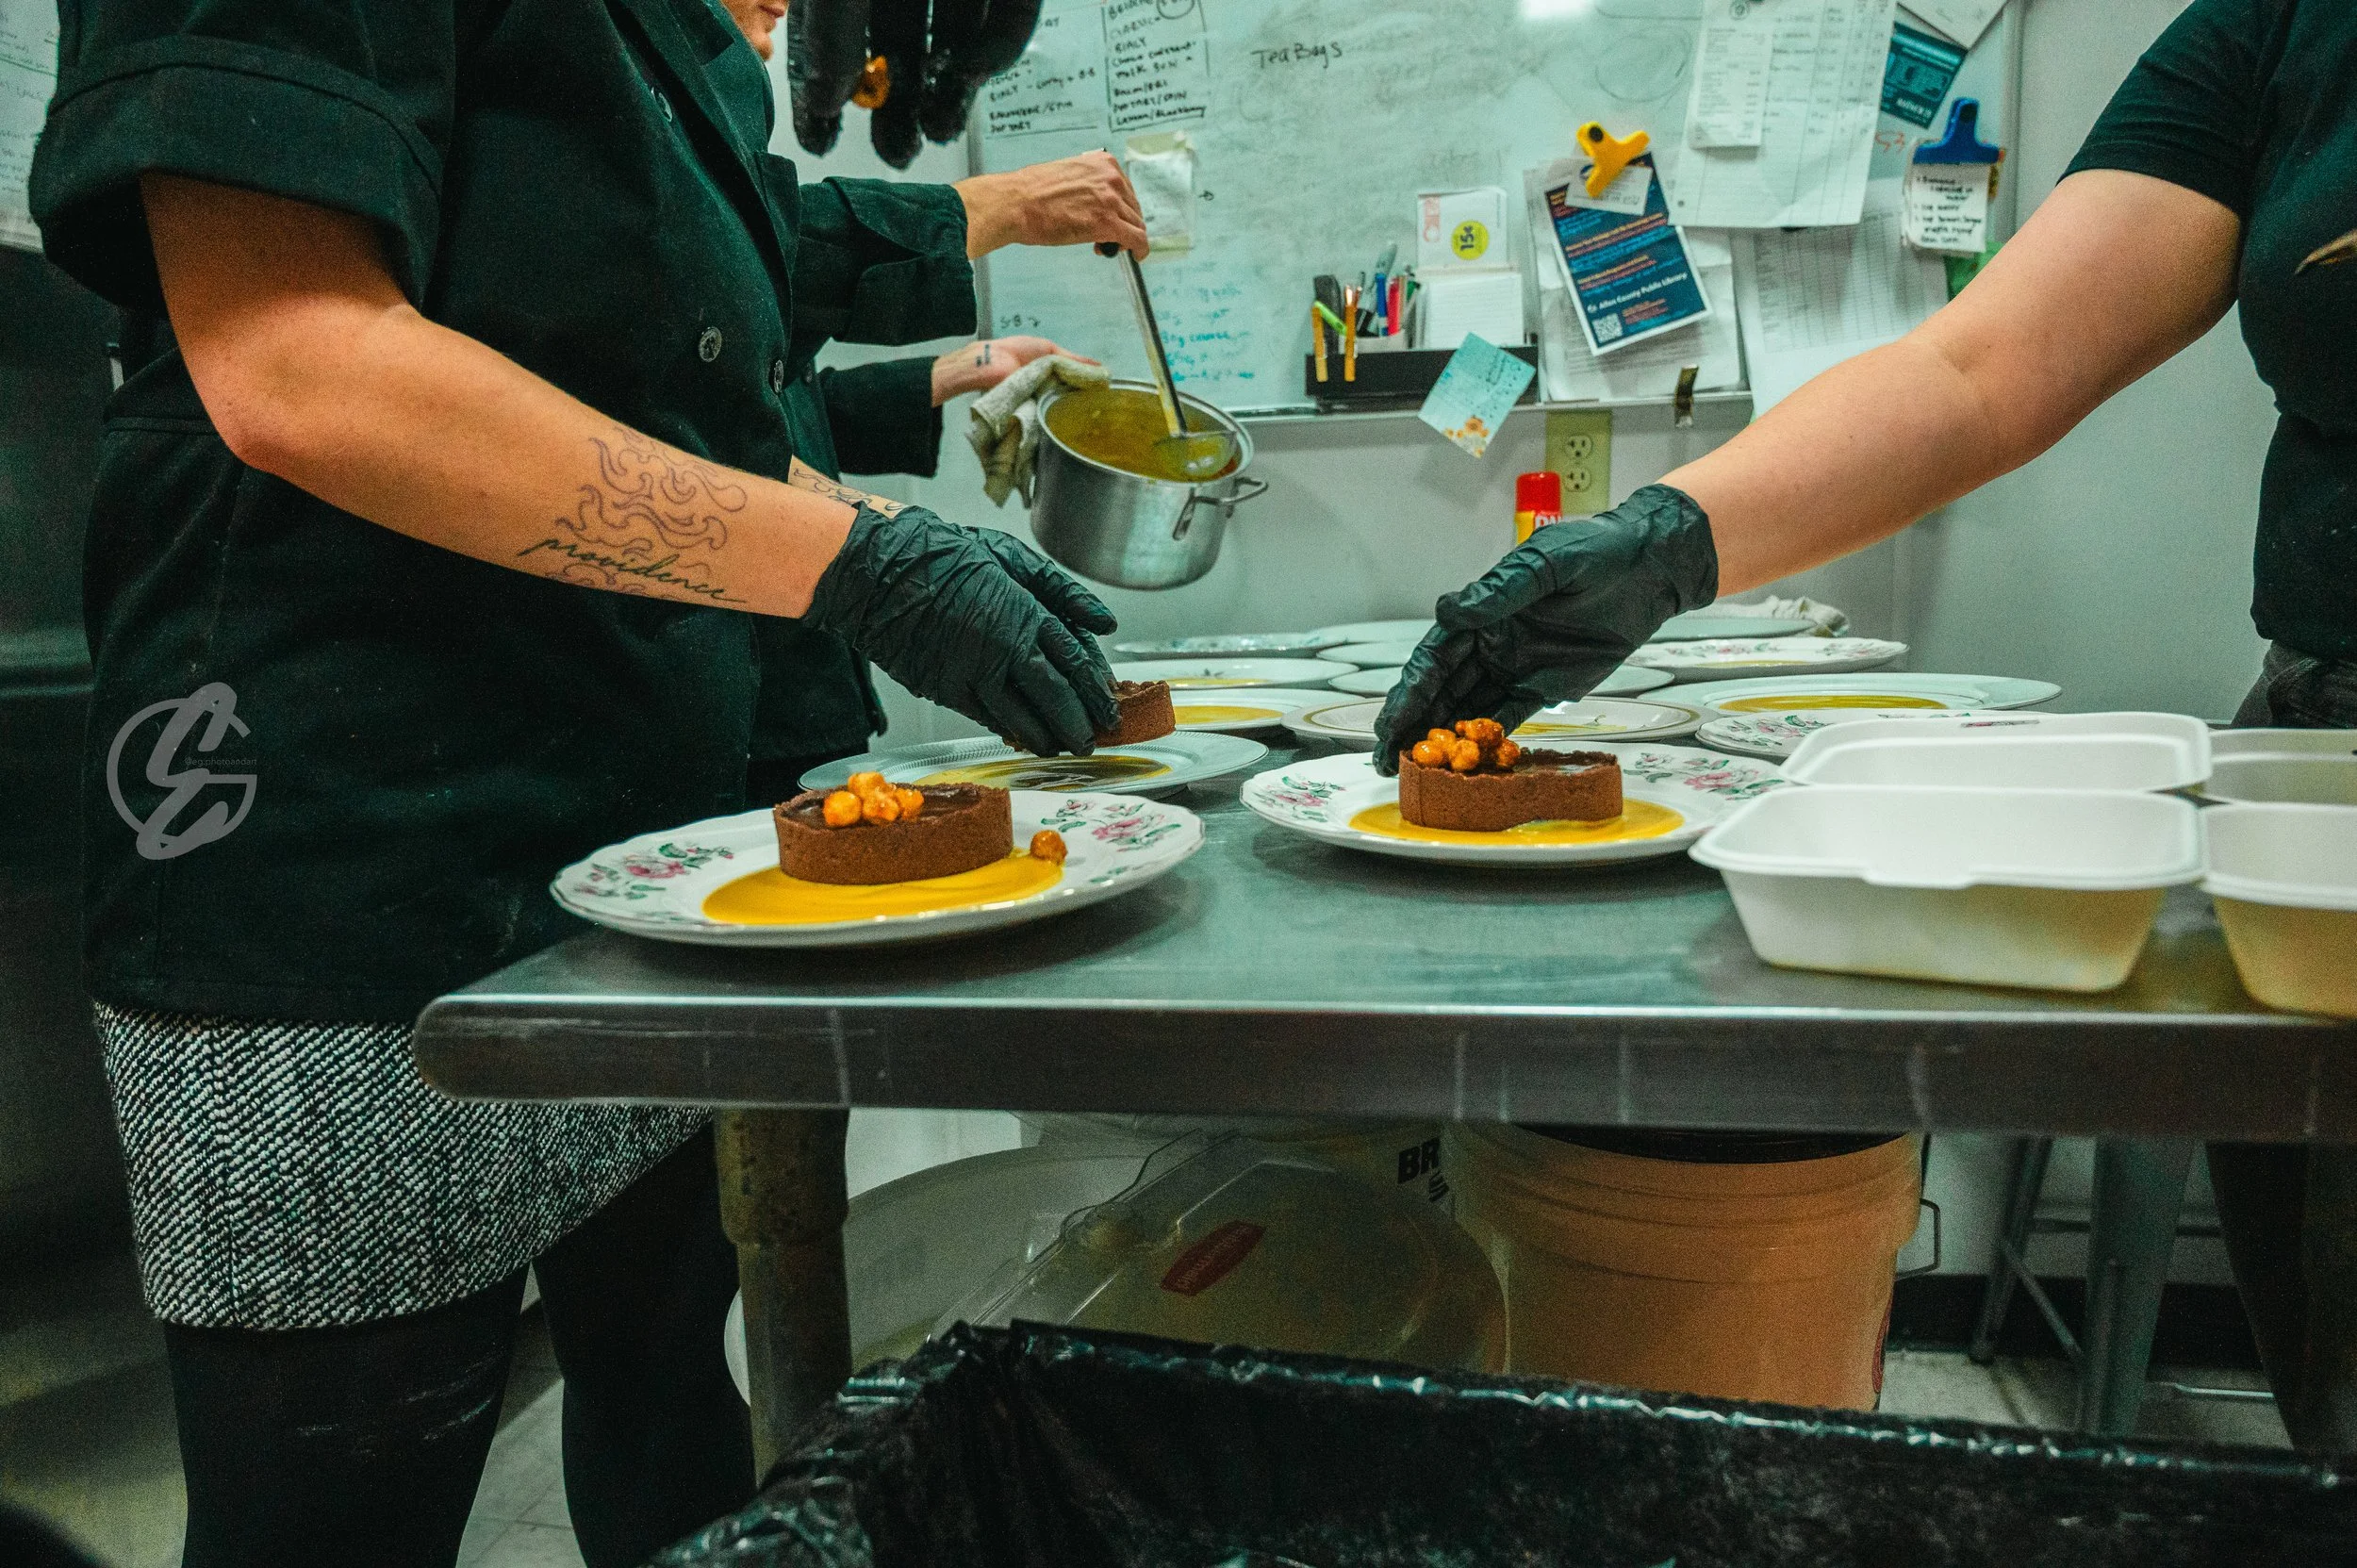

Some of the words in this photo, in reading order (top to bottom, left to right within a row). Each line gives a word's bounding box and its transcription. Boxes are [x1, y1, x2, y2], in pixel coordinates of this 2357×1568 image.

[1616, 287, 1641, 304] County
[1640, 280, 1662, 294] Public
[1661, 272, 1689, 287] Library
[517, 536, 747, 603] providence
